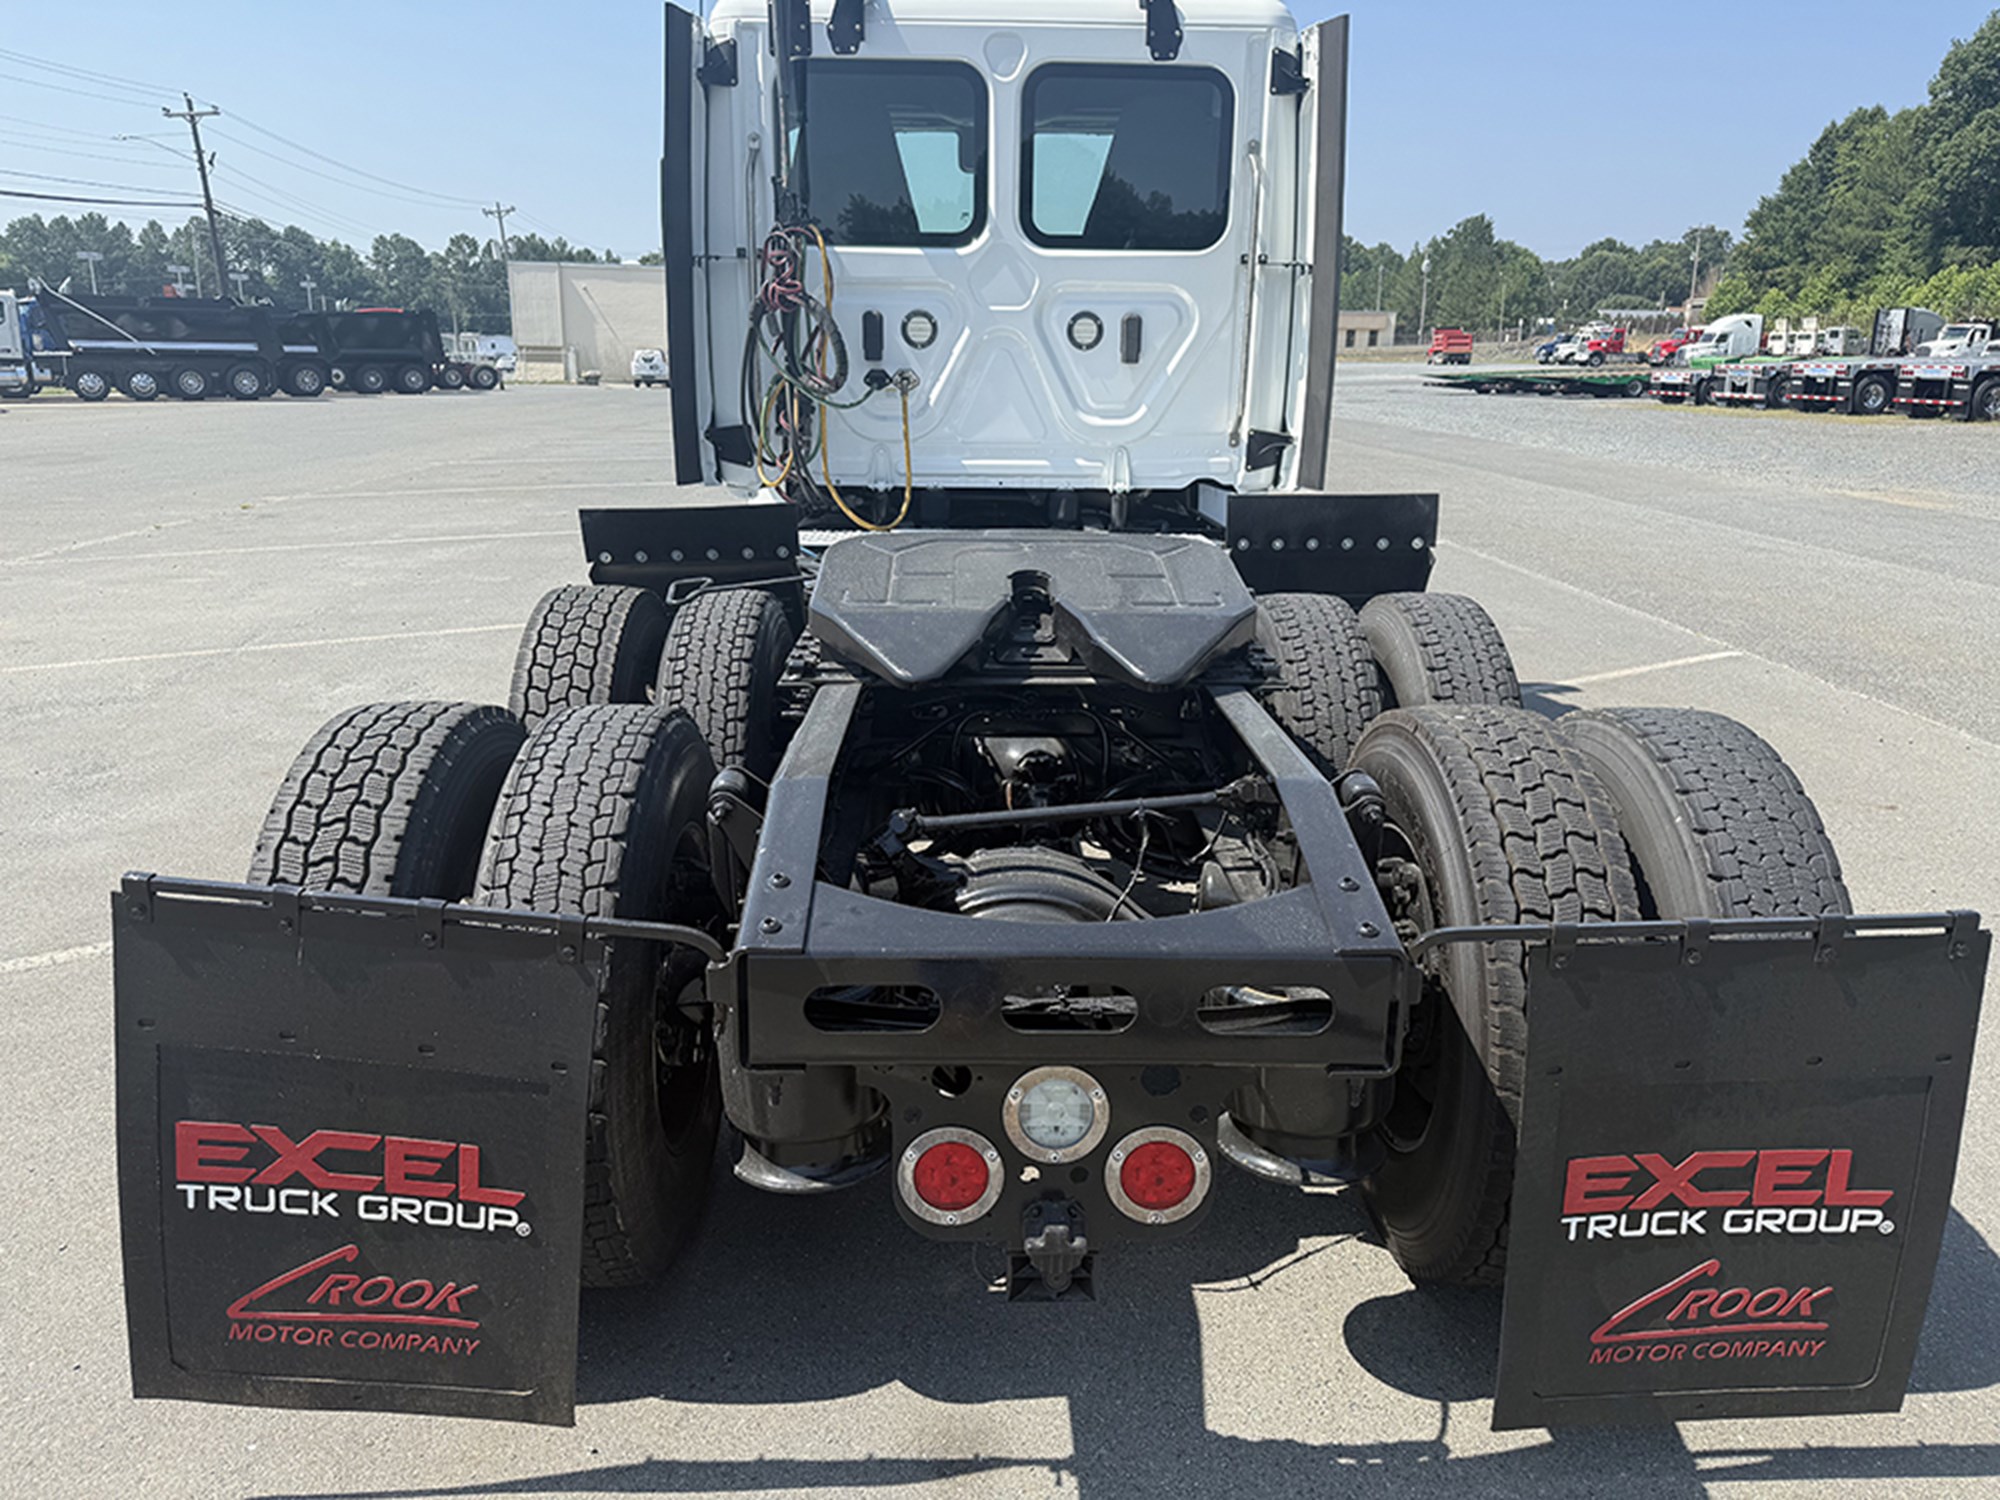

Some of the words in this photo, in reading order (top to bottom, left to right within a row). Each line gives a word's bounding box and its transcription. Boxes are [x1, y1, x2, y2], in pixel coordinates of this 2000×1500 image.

[176, 1121, 525, 1206] EXCEL
[1564, 1150, 1894, 1214] EXCEL
[177, 1184, 339, 1217] TRUCK
[1561, 1210, 1707, 1241] TRUCK
[229, 1323, 333, 1347] MOTOR
[341, 1331, 480, 1356] COMPANY
[1589, 1343, 1684, 1364] MOTOR
[1693, 1341, 1826, 1360] COMPANY
